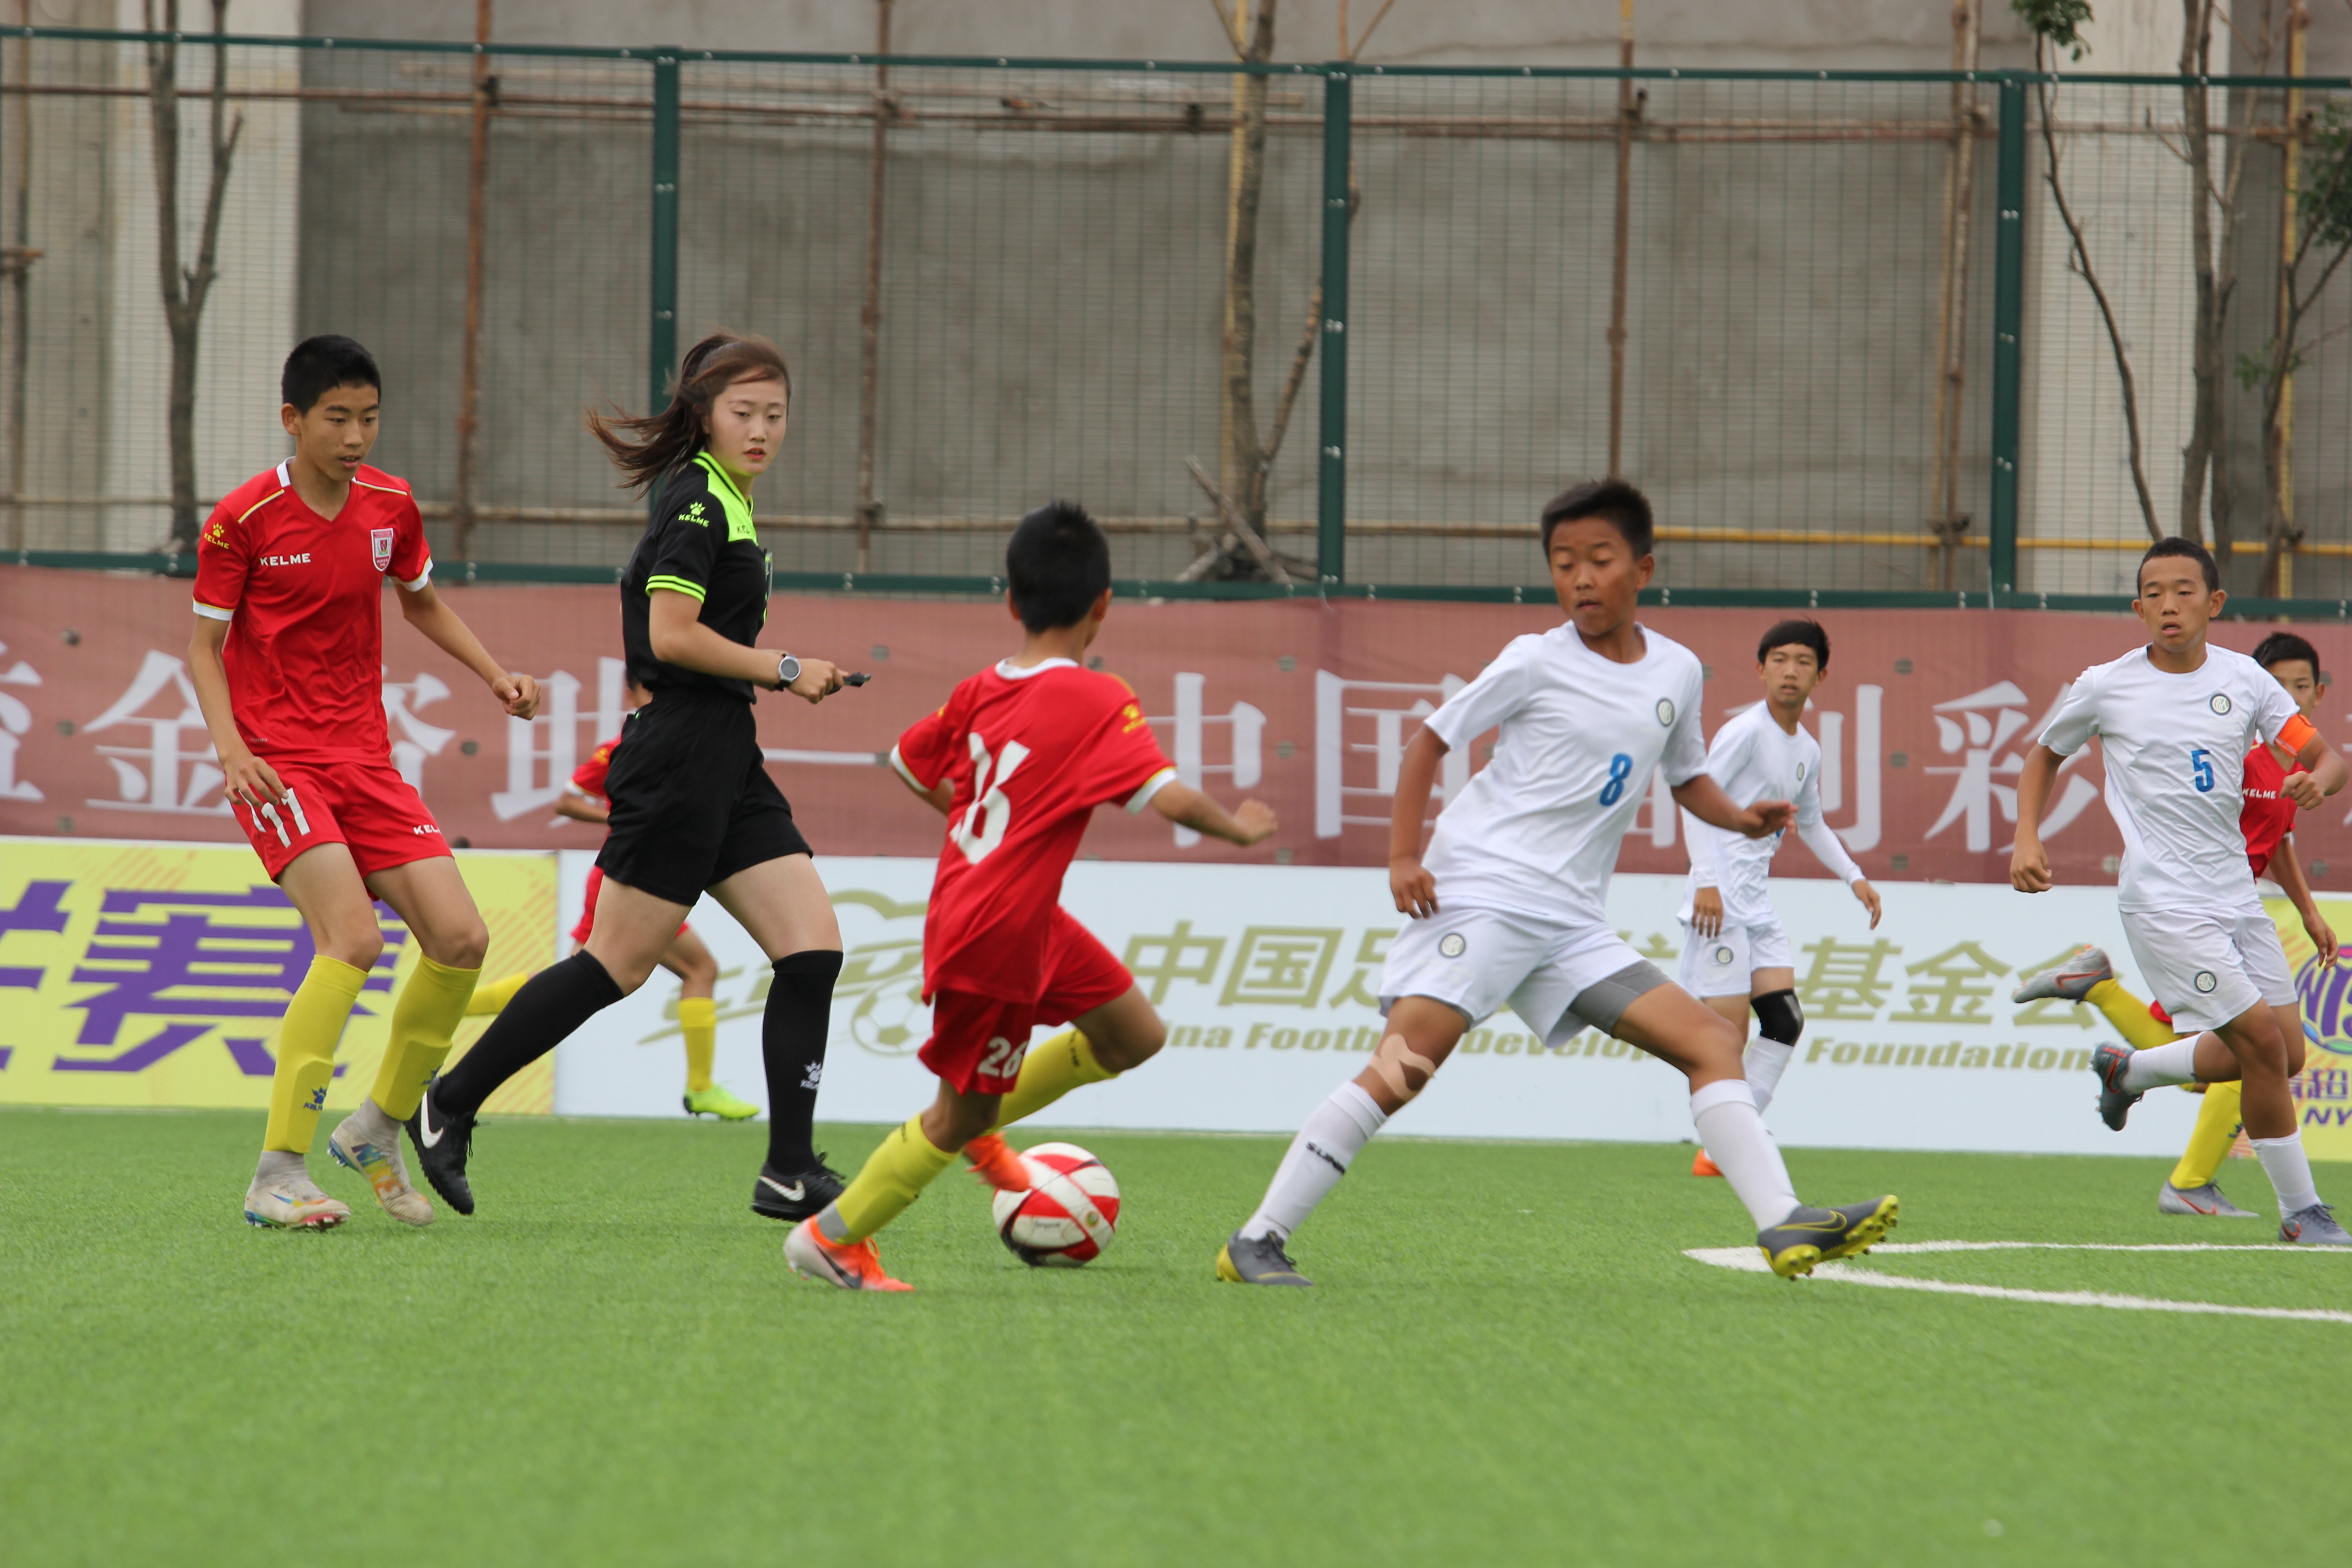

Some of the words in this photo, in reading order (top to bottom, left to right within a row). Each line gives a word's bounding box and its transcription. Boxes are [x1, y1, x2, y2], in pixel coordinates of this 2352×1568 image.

[678, 513, 710, 528] KELME
[203, 532, 230, 549] KELME
[260, 553, 311, 566] KELME
[1599, 753, 1632, 806] 8
[2191, 749, 2215, 793] 5
[2242, 788, 2277, 800] KELME
[413, 824, 442, 835] KEL
[0, 879, 407, 1077] 赛
[977, 1036, 1029, 1079] 26
[1245, 1022, 1382, 1051] Footb
[1805, 1037, 2092, 1071] Foundation
